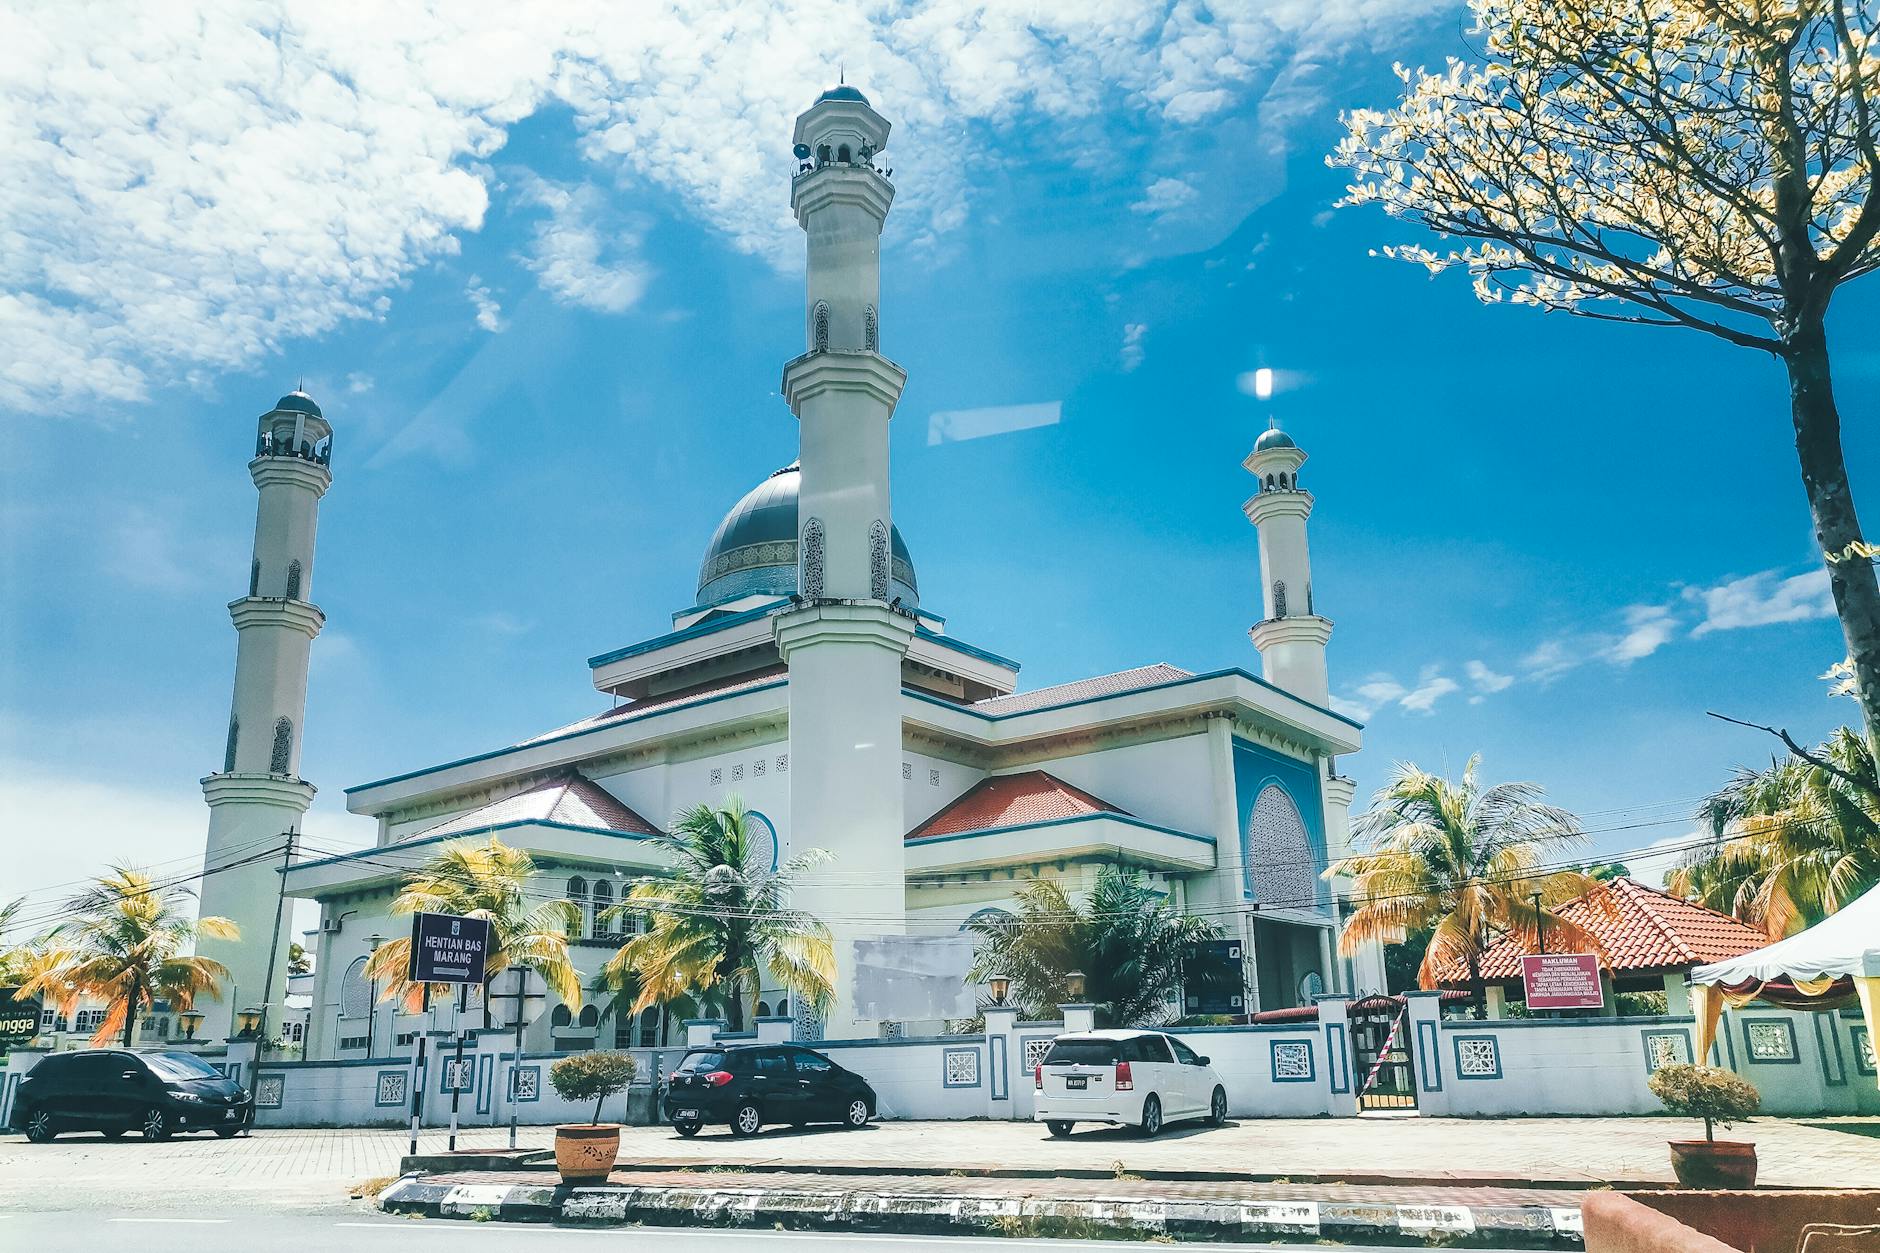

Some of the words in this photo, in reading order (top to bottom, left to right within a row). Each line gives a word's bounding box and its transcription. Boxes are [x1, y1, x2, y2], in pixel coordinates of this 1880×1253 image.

[425, 936, 463, 950] HENTIAN
[465, 940, 481, 951] BAS
[433, 950, 472, 964] MARANG
[0, 1018, 34, 1034] ngga
